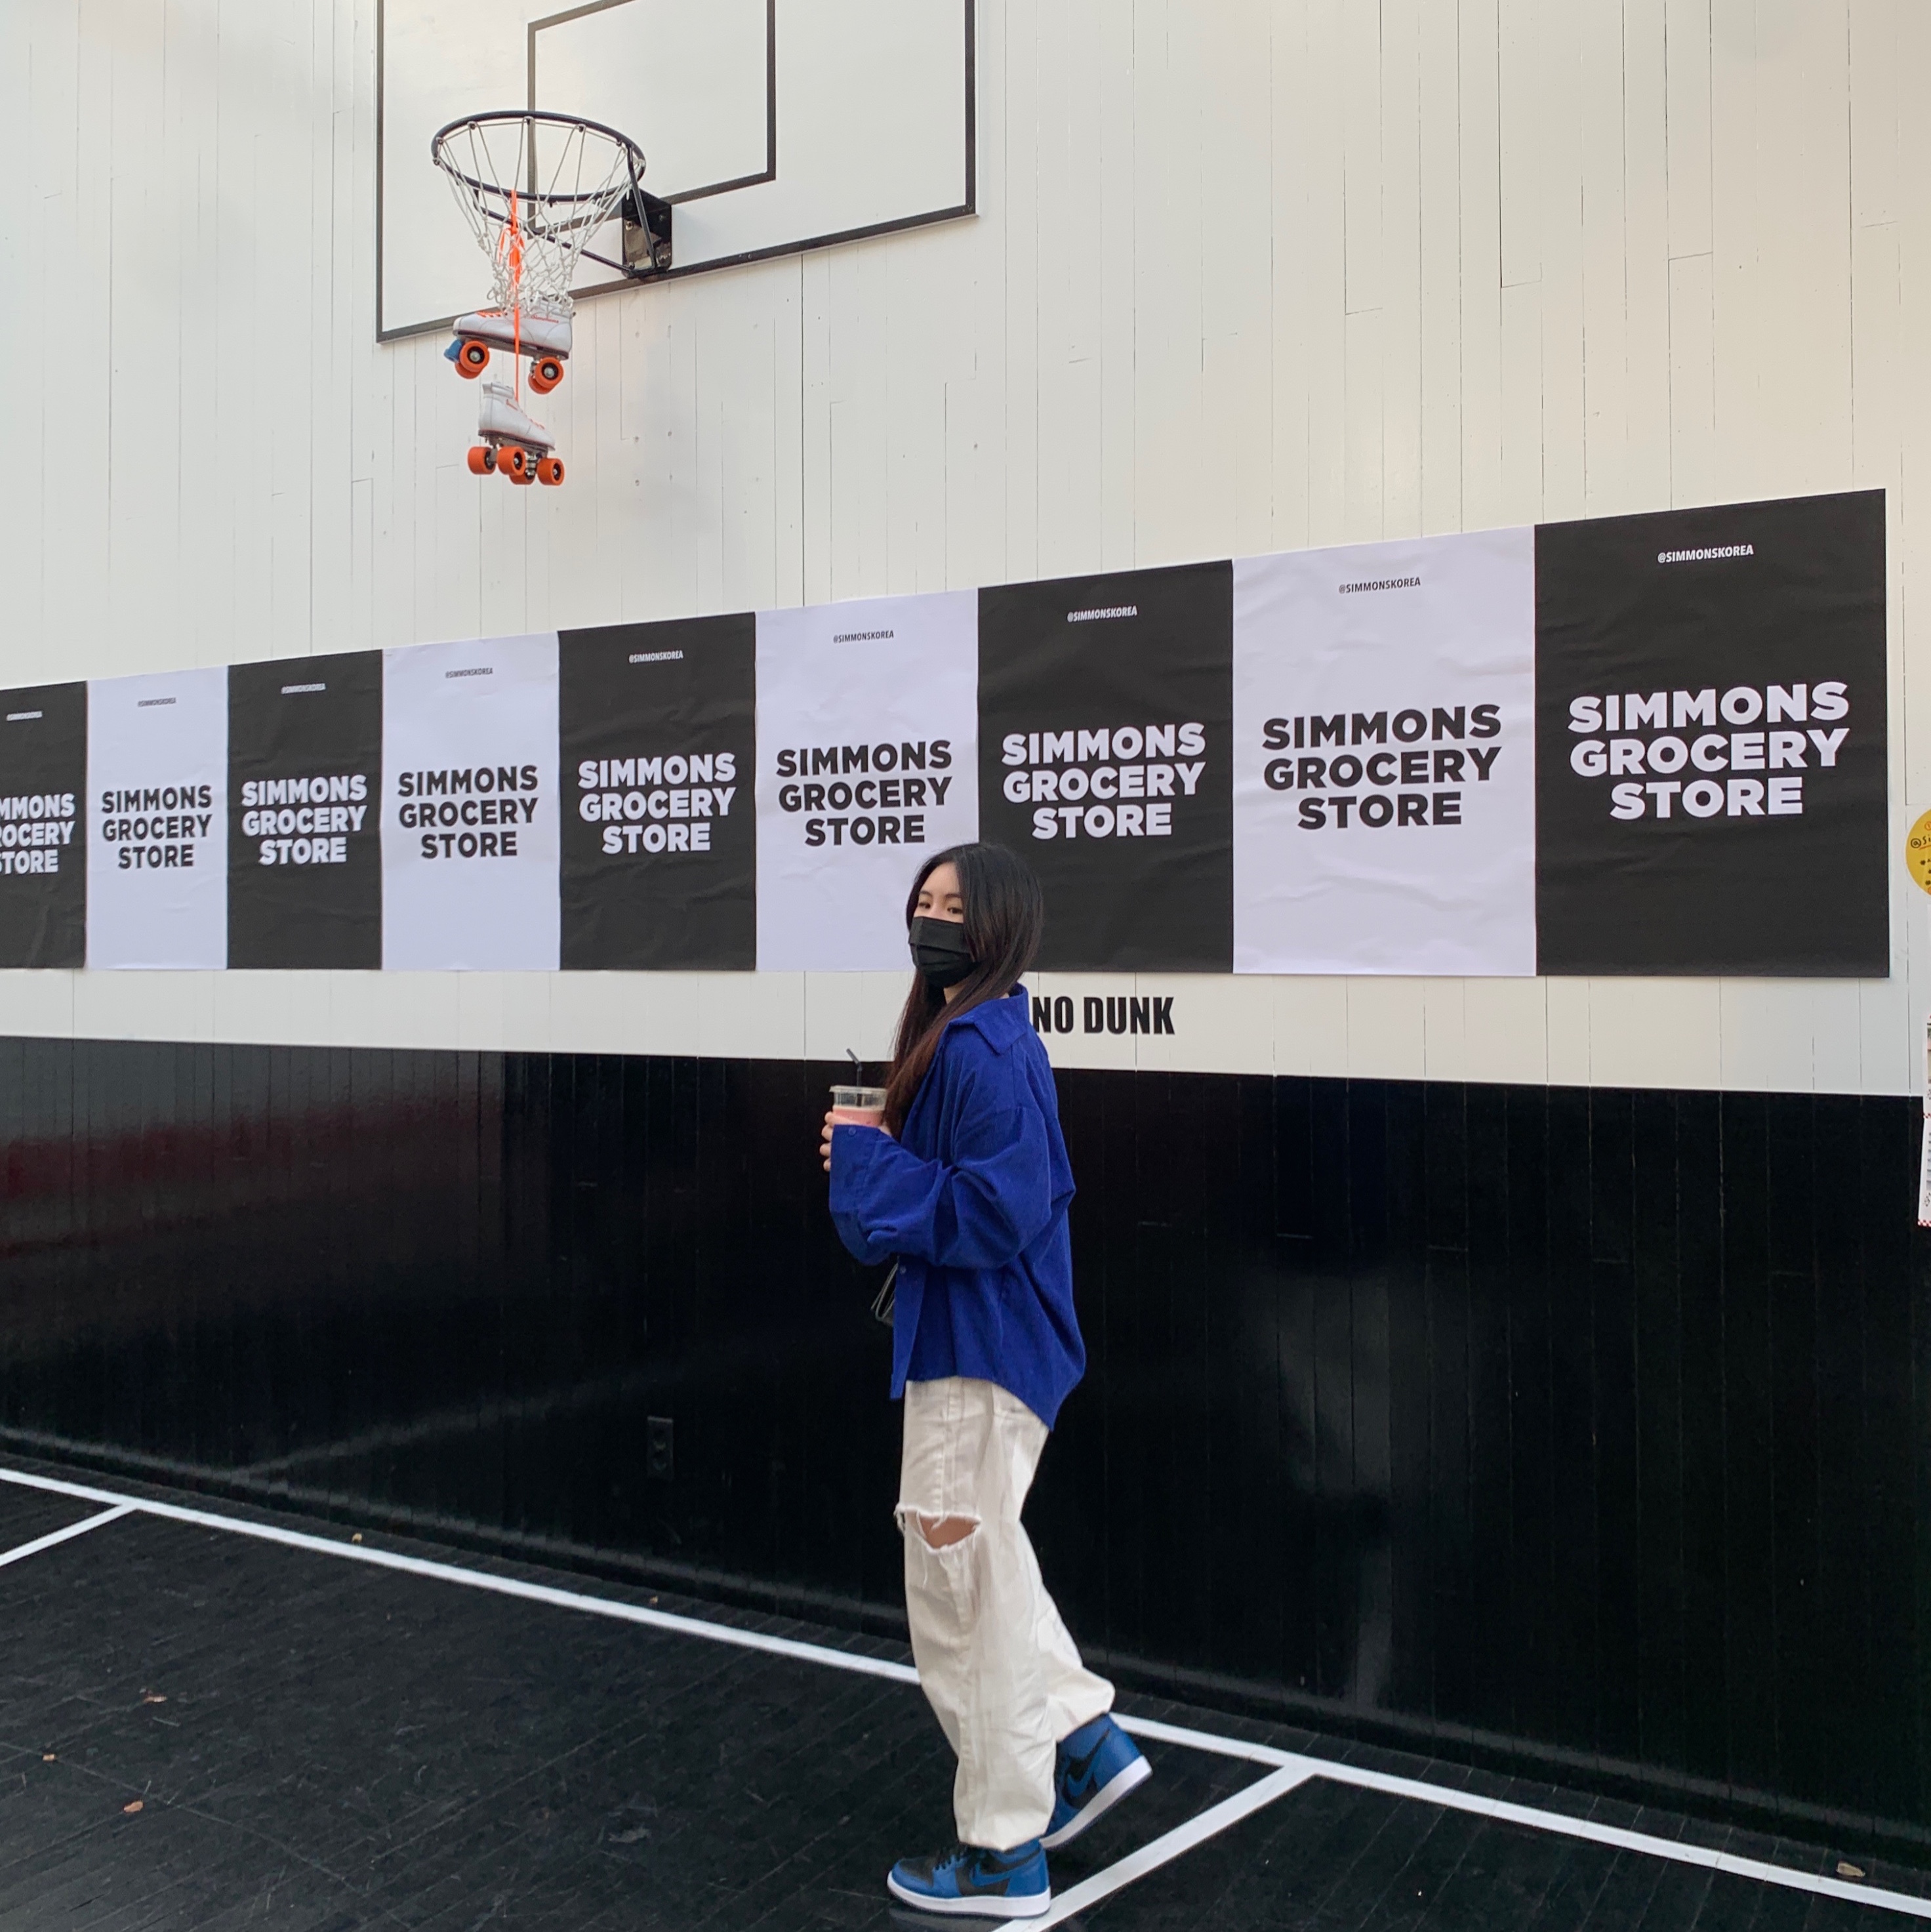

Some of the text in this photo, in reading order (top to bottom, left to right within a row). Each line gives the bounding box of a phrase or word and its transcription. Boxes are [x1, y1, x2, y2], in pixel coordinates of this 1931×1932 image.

[1657, 545, 1754, 563] @SIMMONSKOREA
[1339, 577, 1421, 594] @SIMMONSKOREA
[1067, 606, 1137, 623] @SIMMONSKOREA
[833, 630, 894, 644] @SIMMONSKOREA
[629, 650, 683, 663] @SIMMONSKOREA
[1568, 682, 1849, 733] SIMMONS
[1263, 705, 1501, 750] SIMMONS
[776, 739, 952, 777] SIMMONS
[1002, 723, 1206, 765] SIMMONS
[1570, 728, 1850, 777] GROCERY
[397, 765, 538, 797] SIMMONS
[578, 752, 736, 789] SIMMONS
[1004, 762, 1206, 802] GROCERY
[1264, 747, 1502, 791] GROCERY
[102, 785, 212, 813] SIMMONS
[241, 774, 367, 807] SIMMONS
[579, 787, 736, 822] GROCERY
[779, 776, 952, 812] GROCERY
[1610, 777, 1803, 819] STORE
[242, 805, 367, 836] GROCERY
[399, 797, 539, 829] GROCERY
[1032, 803, 1172, 839] STORE
[1298, 792, 1462, 830] STORE
[0, 821, 75, 848] OCERY
[102, 814, 213, 842] GROCERY
[602, 822, 710, 854] STORE
[805, 814, 925, 847] STORE
[118, 844, 193, 869] STORE
[259, 836, 346, 865] STORE
[421, 831, 518, 859] STORE
[0, 849, 58, 874] TORE
[1032, 996, 1175, 1035] NO DUNK
